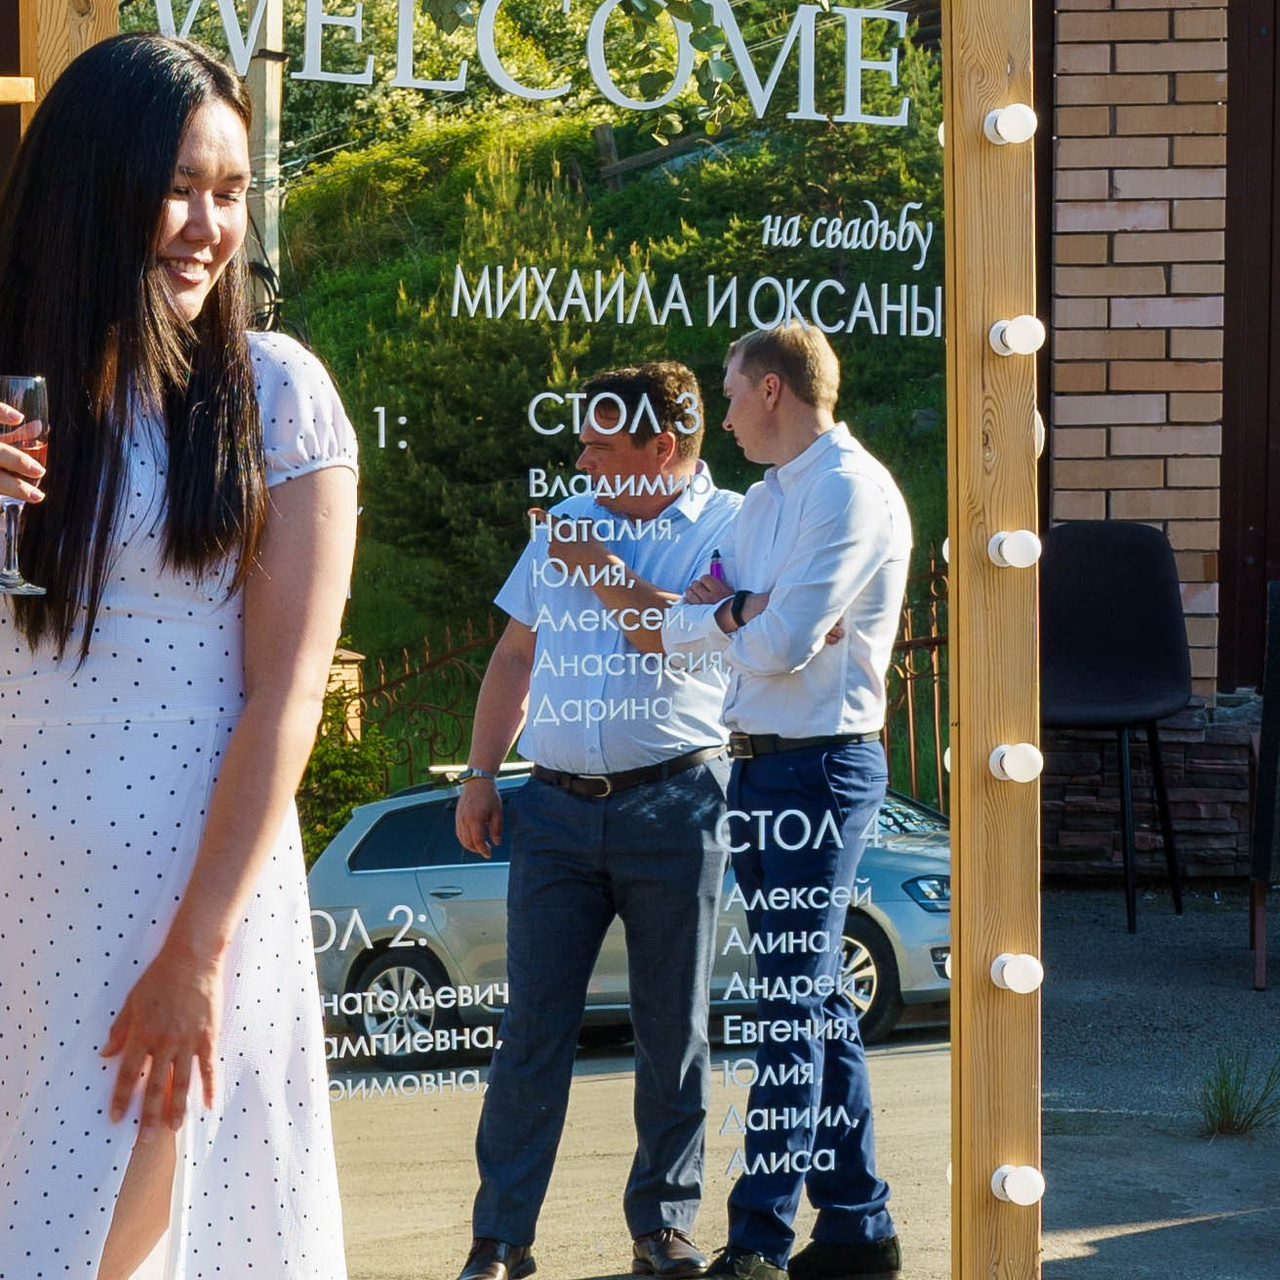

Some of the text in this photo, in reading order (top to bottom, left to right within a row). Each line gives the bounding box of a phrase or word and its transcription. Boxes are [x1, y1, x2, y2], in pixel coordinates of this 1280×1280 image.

[761, 199, 933, 271] на свадьбу
[451, 264, 943, 338] МИХАИЛА И ОКСАНЫ
[372, 406, 408, 450] 1:
[527, 391, 701, 436] СТОЛ 3
[530, 512, 682, 544] Наталия,
[531, 557, 636, 589] Юлия,
[530, 598, 694, 633] Алексей,
[532, 648, 732, 678] Анастасия,
[532, 693, 674, 729] Дарина
[715, 808, 845, 853] СТОЛ
[311, 904, 428, 954] ОЛ 2:
[721, 926, 841, 956] Алина,
[321, 982, 509, 1016] натольевич
[722, 967, 866, 1005] Андрей,
[323, 1026, 504, 1060] ампиевна,
[723, 1014, 858, 1045] Евгения,
[723, 1057, 824, 1089] Юлия,
[720, 1101, 860, 1136] Даниил,
[724, 1147, 836, 1176] Алиса
